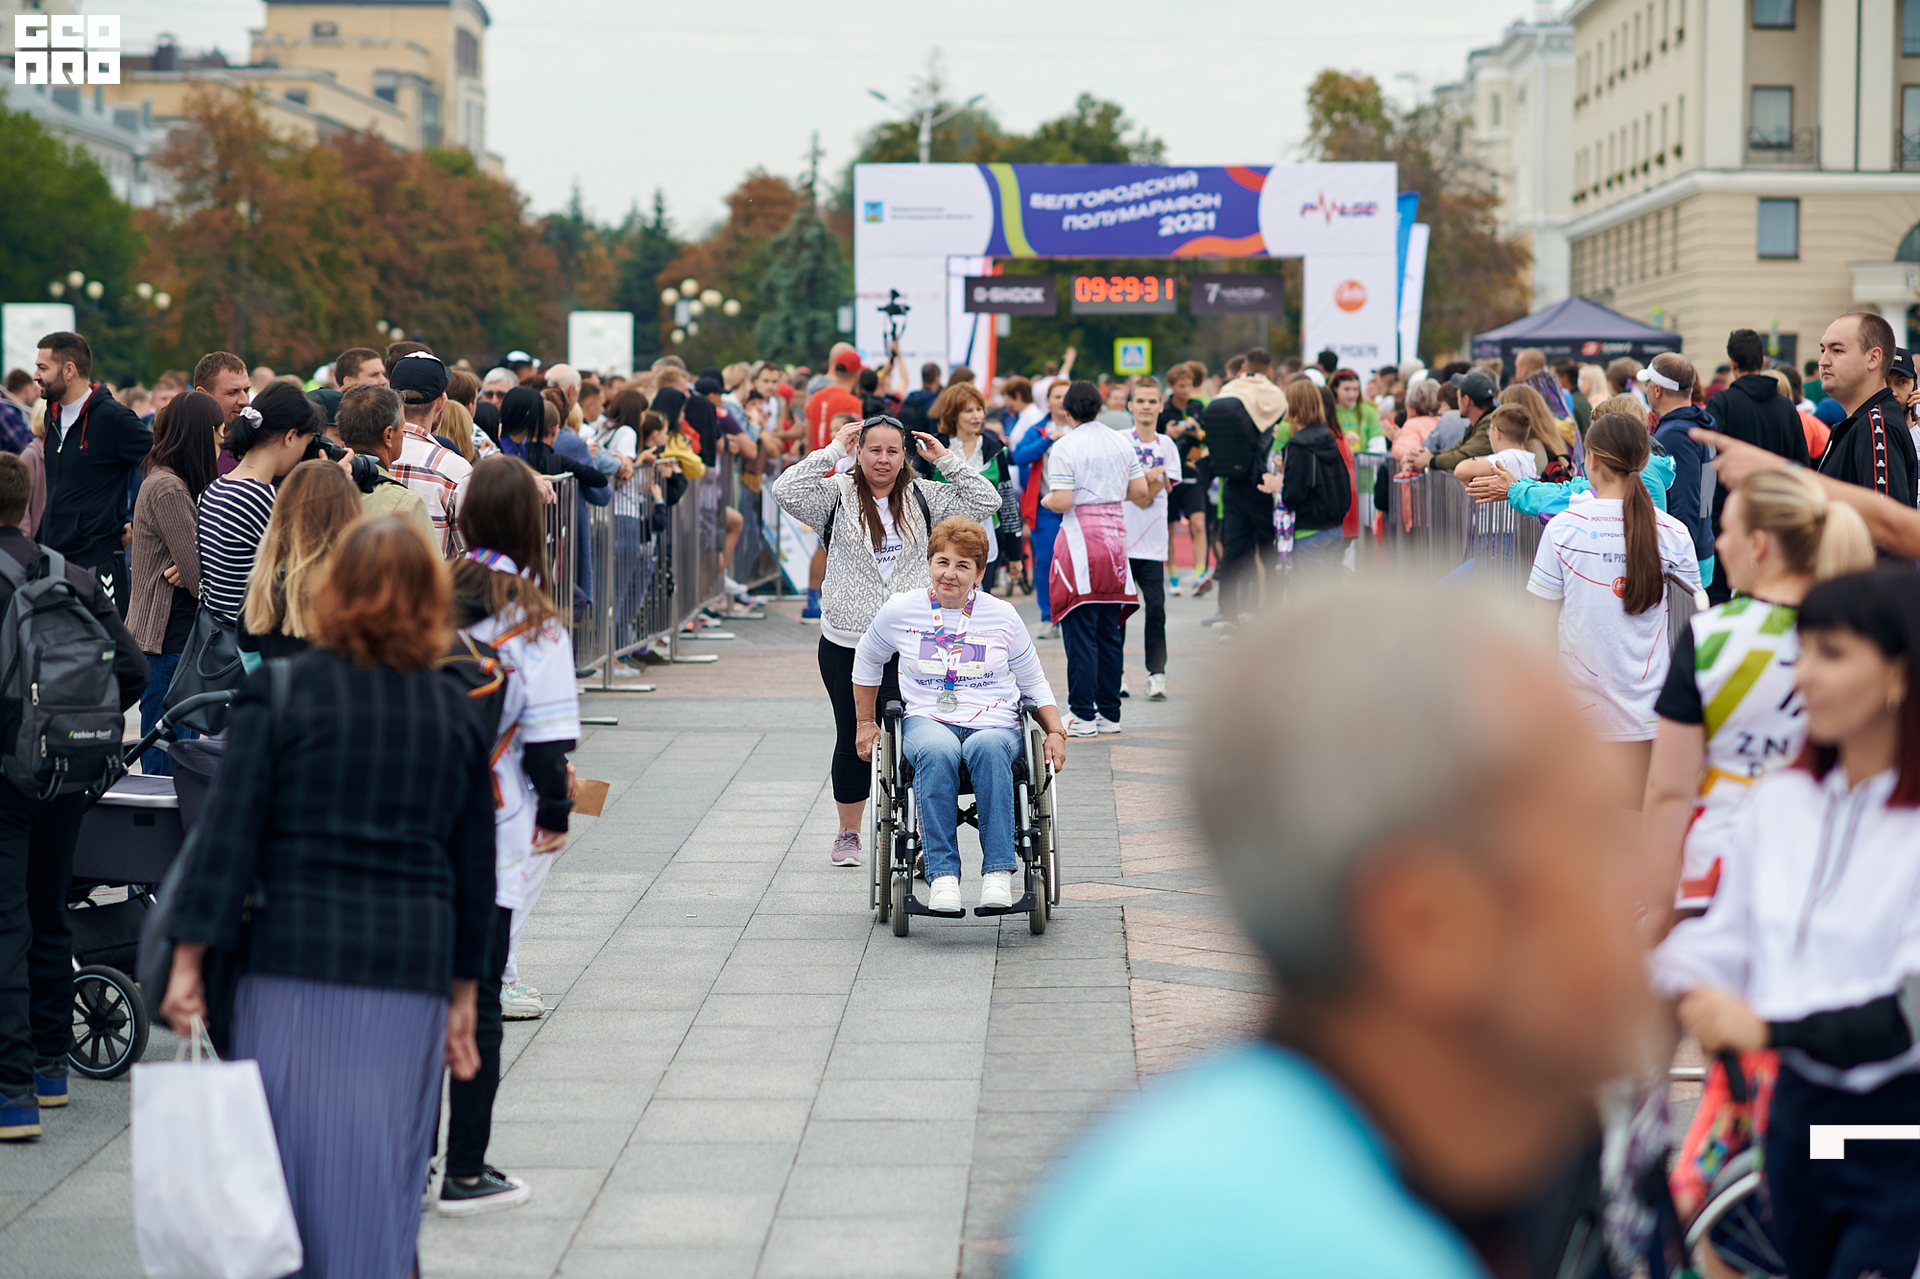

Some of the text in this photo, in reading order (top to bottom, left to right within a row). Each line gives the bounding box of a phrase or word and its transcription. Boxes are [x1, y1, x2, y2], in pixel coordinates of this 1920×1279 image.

[1029, 170, 1198, 210] БЕЛГОРОДСКИЙ
[1062, 192, 1222, 232] ПОЛУМАРАФОН
[1157, 210, 1216, 237] 2021
[1075, 276, 1174, 303] 09:29:31
